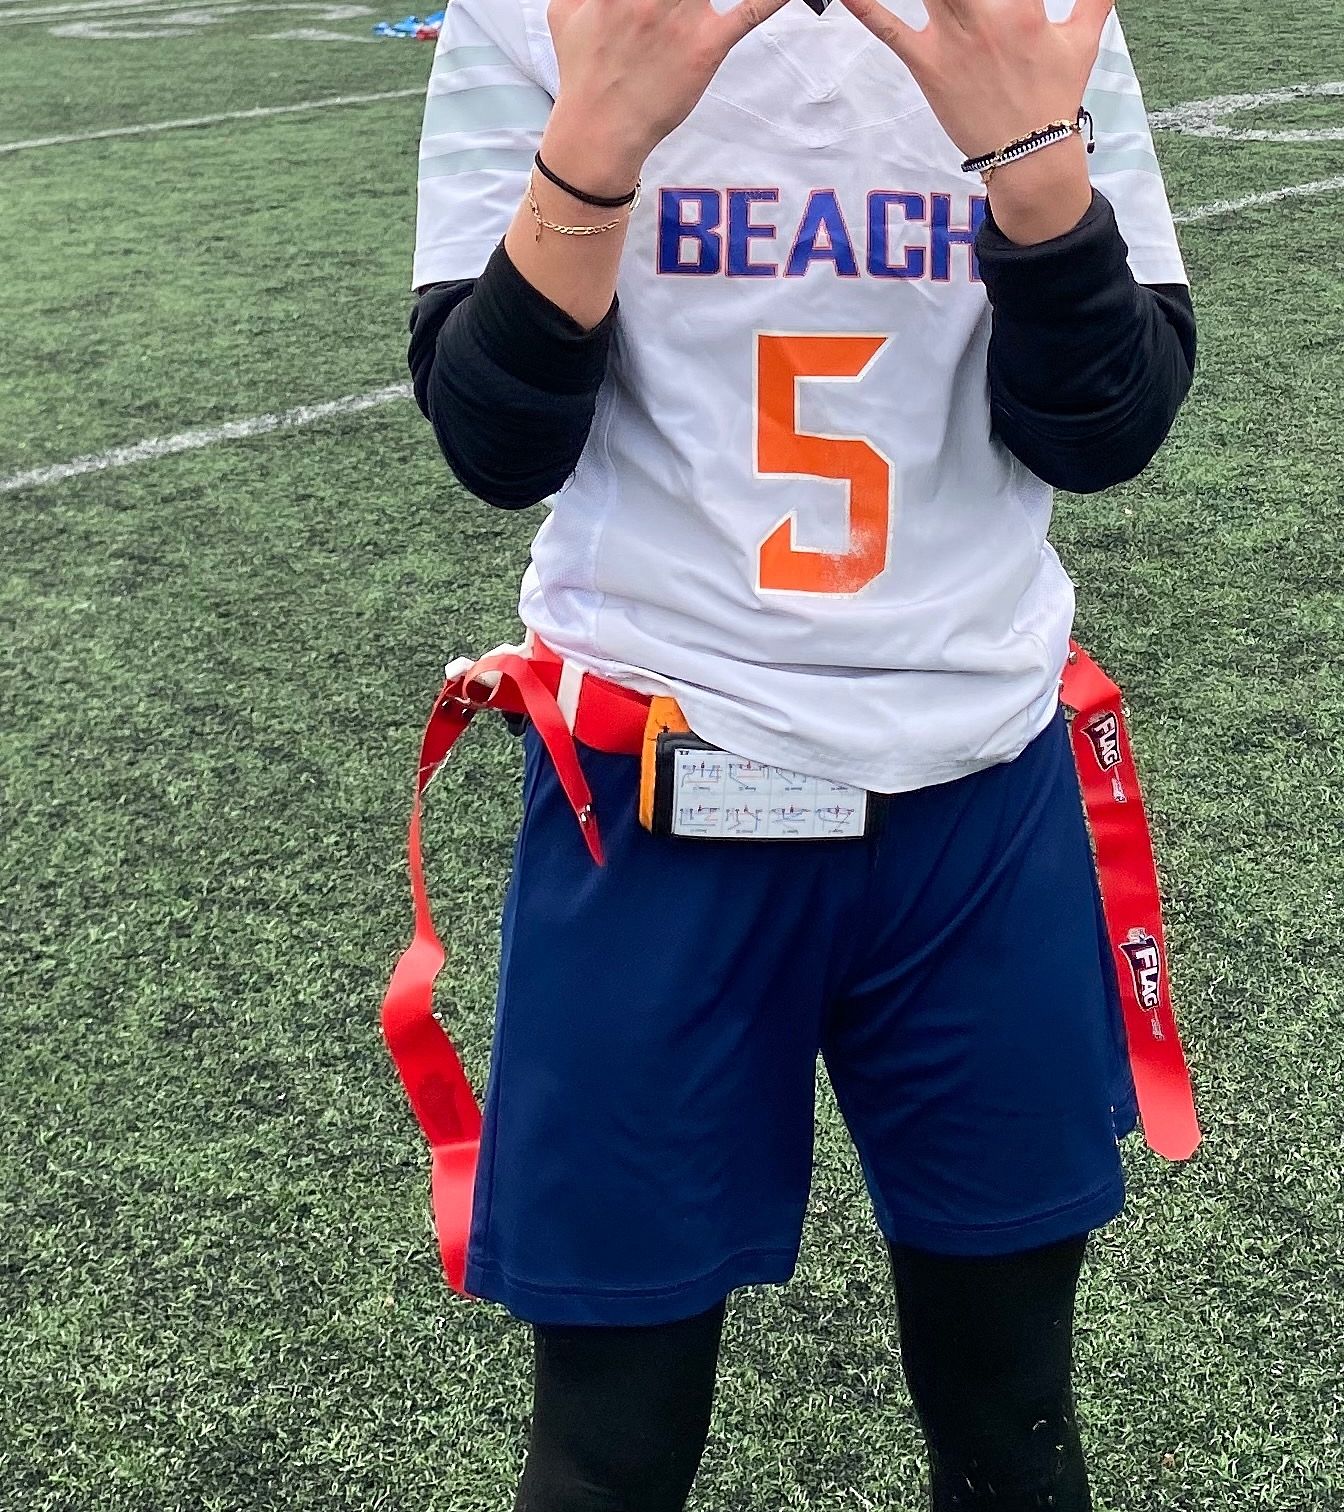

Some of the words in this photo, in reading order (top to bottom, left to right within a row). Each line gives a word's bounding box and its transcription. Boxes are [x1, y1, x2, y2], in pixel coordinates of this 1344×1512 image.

[656, 187, 985, 284] BEACH
[751, 329, 896, 600] 5
[1093, 716, 1118, 766] FLAG
[1135, 946, 1159, 1007] FLAG
